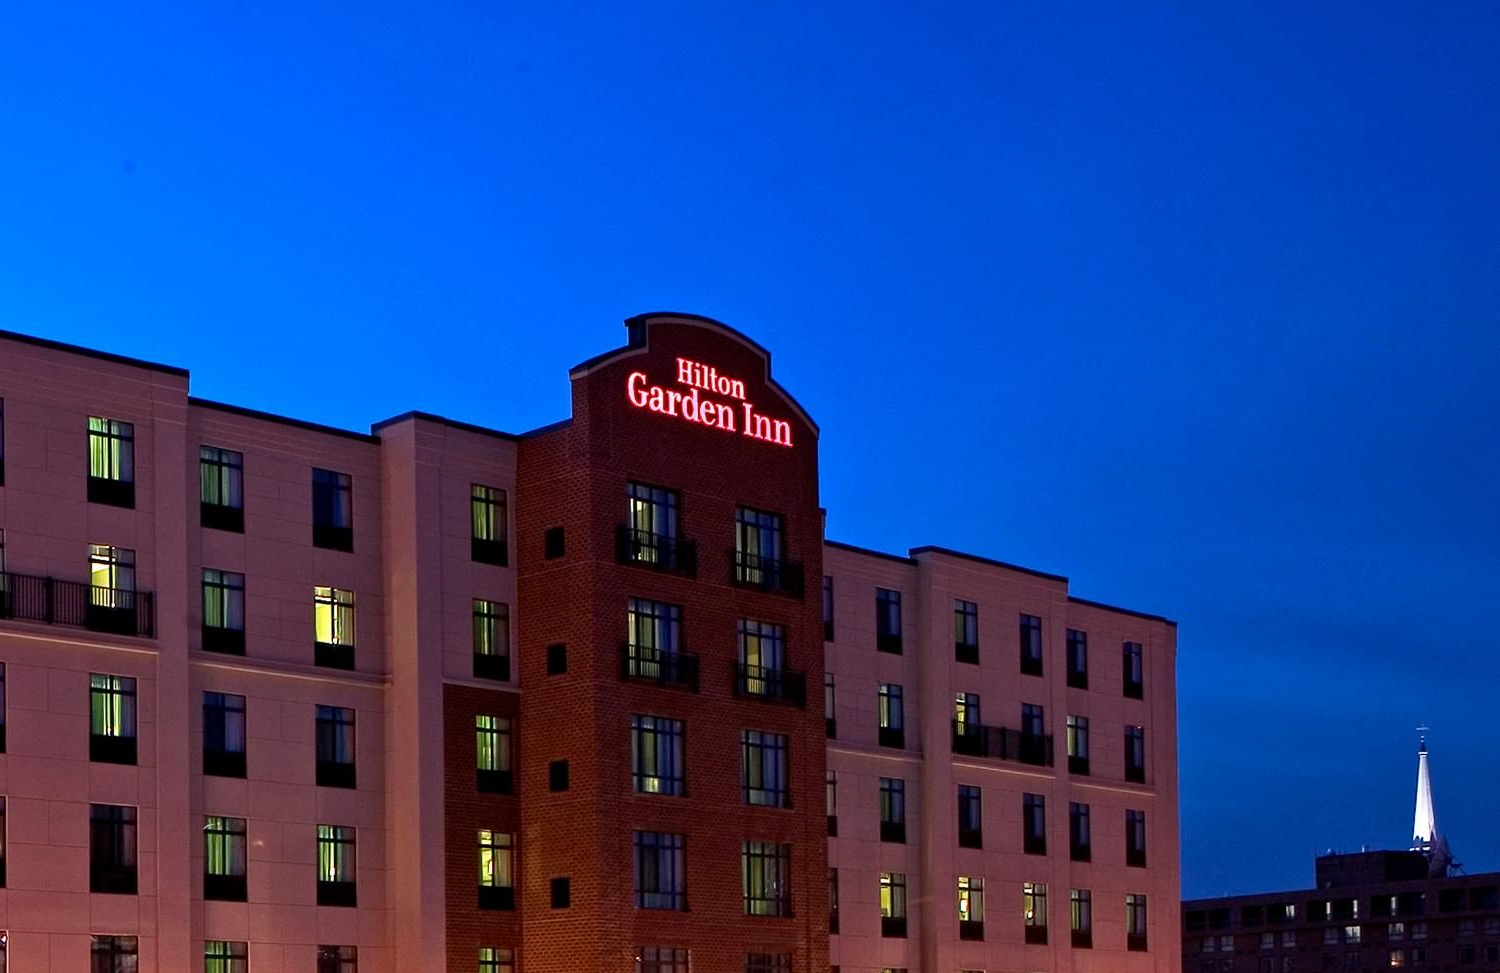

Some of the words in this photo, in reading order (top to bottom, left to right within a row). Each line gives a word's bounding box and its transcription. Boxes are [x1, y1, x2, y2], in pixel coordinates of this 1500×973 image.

[676, 358, 746, 400] Hilton
[627, 372, 736, 432] Garden
[743, 401, 793, 447] Inn
